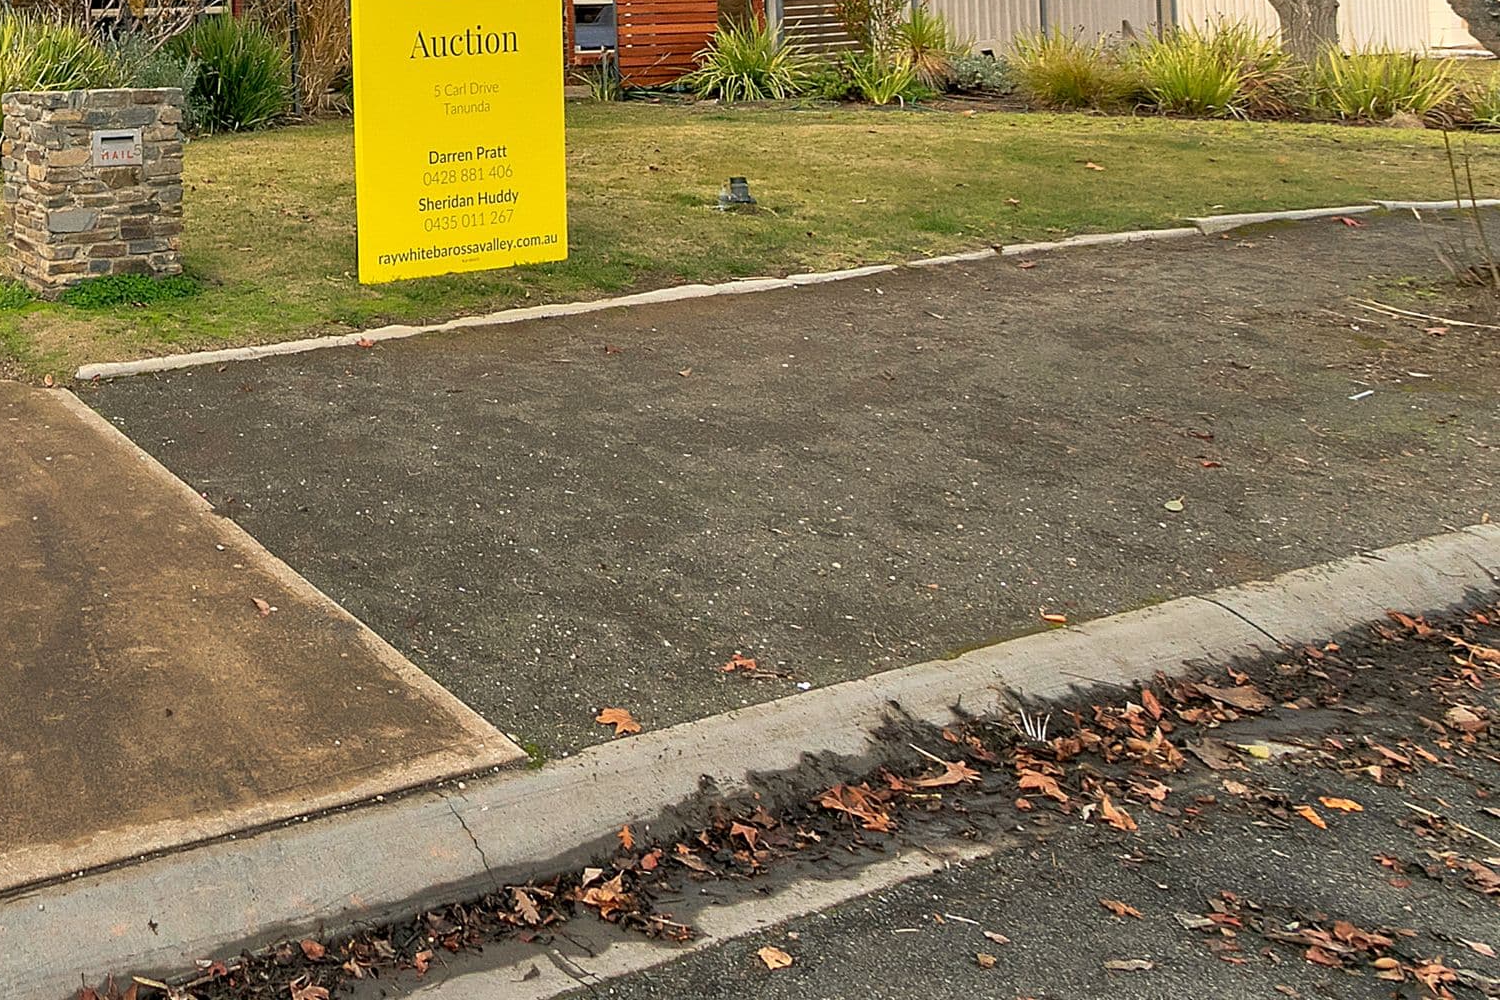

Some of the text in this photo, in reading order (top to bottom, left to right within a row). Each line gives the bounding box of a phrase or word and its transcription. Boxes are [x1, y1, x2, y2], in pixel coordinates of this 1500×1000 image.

[410, 24, 519, 59] Auction
[433, 81, 499, 98] 5 Carl Drive
[443, 100, 491, 116] Tanunda
[101, 150, 133, 160] MAIL
[428, 145, 507, 165] Darren Pratt
[423, 163, 513, 187] 0428 881 406
[418, 188, 519, 212] Sheridan Huddy
[424, 208, 514, 232] 0435 011 267
[377, 233, 558, 266] raywhitebarossavalley.com.au
